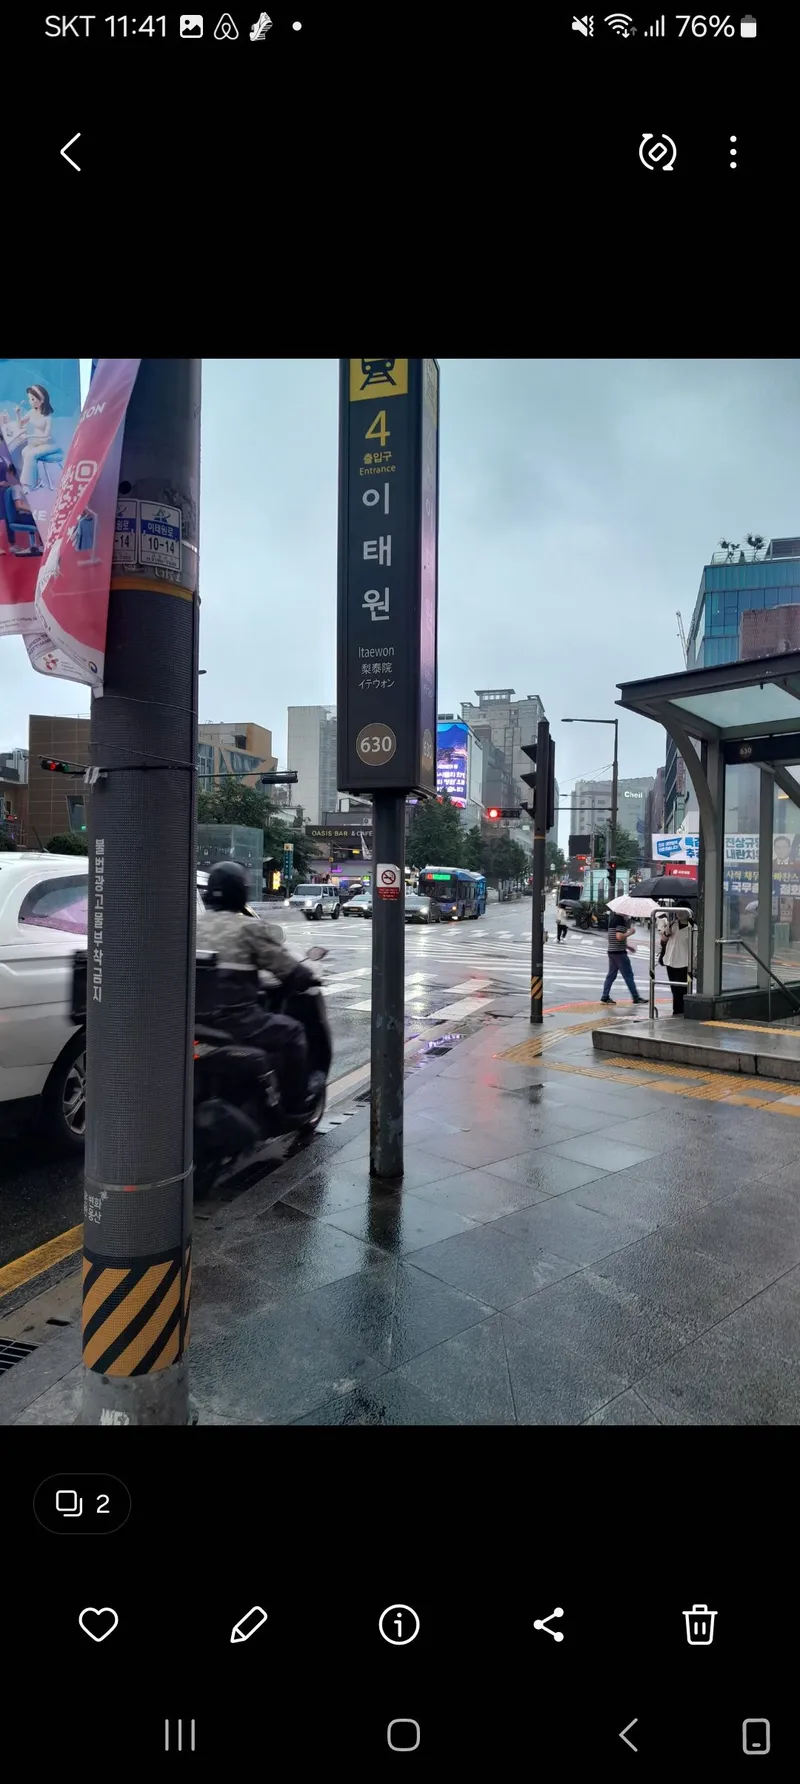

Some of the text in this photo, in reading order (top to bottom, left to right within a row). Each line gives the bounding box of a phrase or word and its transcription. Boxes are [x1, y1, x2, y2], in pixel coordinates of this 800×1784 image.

[365, 410, 391, 447] 4
[363, 451, 393, 465] 출입구
[359, 464, 397, 476] Entrance
[147, 521, 174, 538] 이태원로
[148, 536, 175, 555] 10-14
[361, 482, 392, 621] 이태원
[358, 646, 395, 659] Itaewon
[361, 661, 393, 675] 梨泰院
[358, 678, 395, 690] イテウォン
[360, 736, 392, 753] 630
